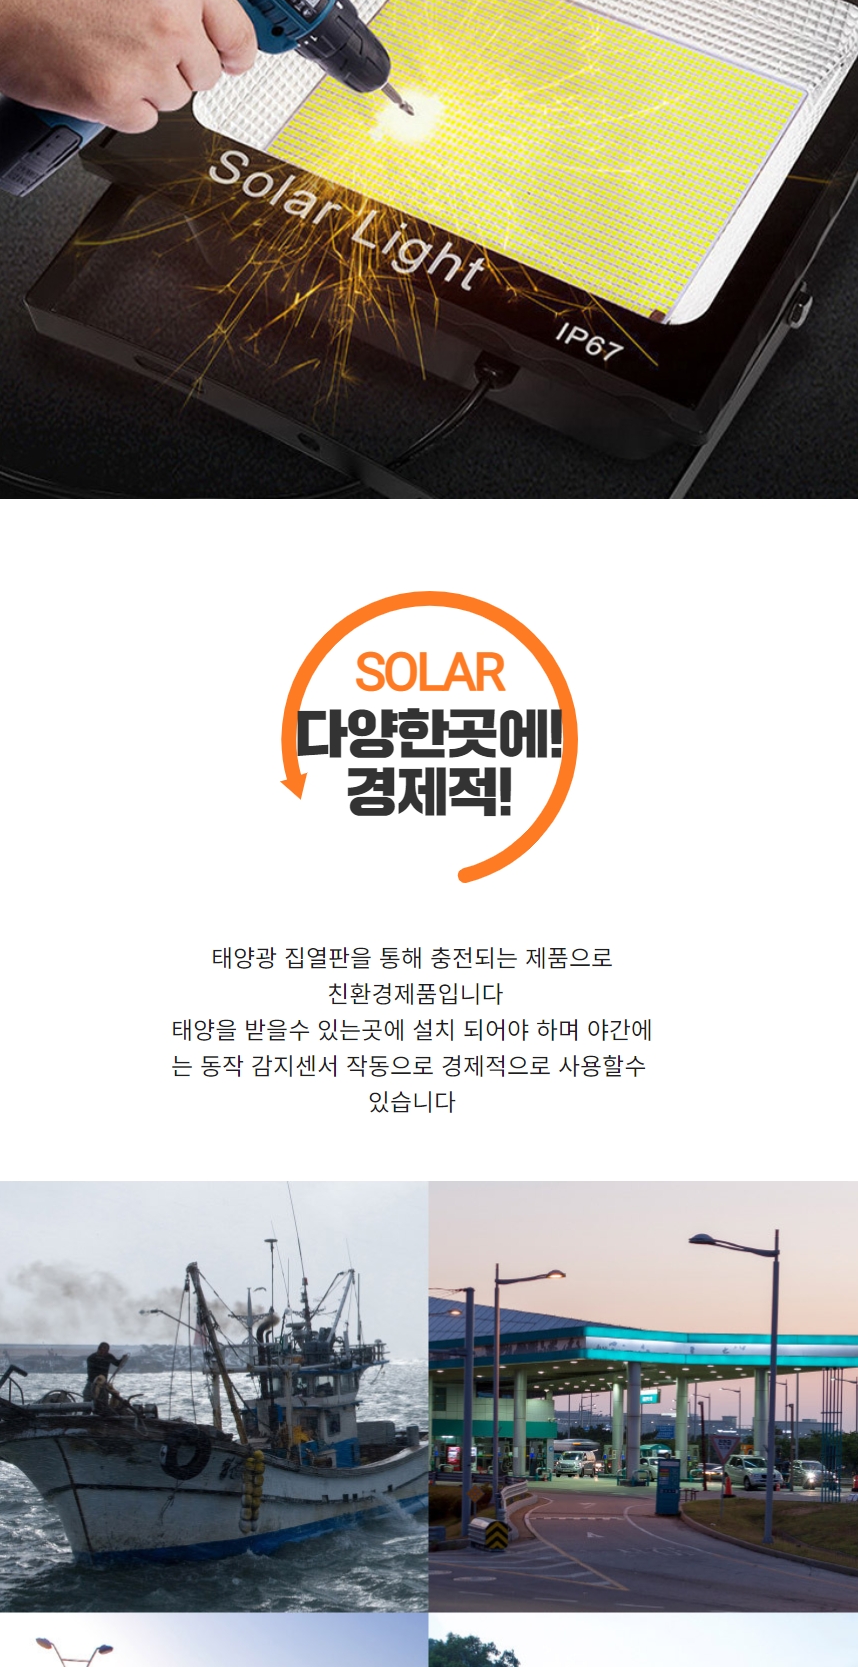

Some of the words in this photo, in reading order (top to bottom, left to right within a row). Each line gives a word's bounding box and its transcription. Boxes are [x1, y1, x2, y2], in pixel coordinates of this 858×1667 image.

[208, 150, 342, 225] Solar
[351, 209, 485, 291] Light
[555, 322, 625, 363] IP67
